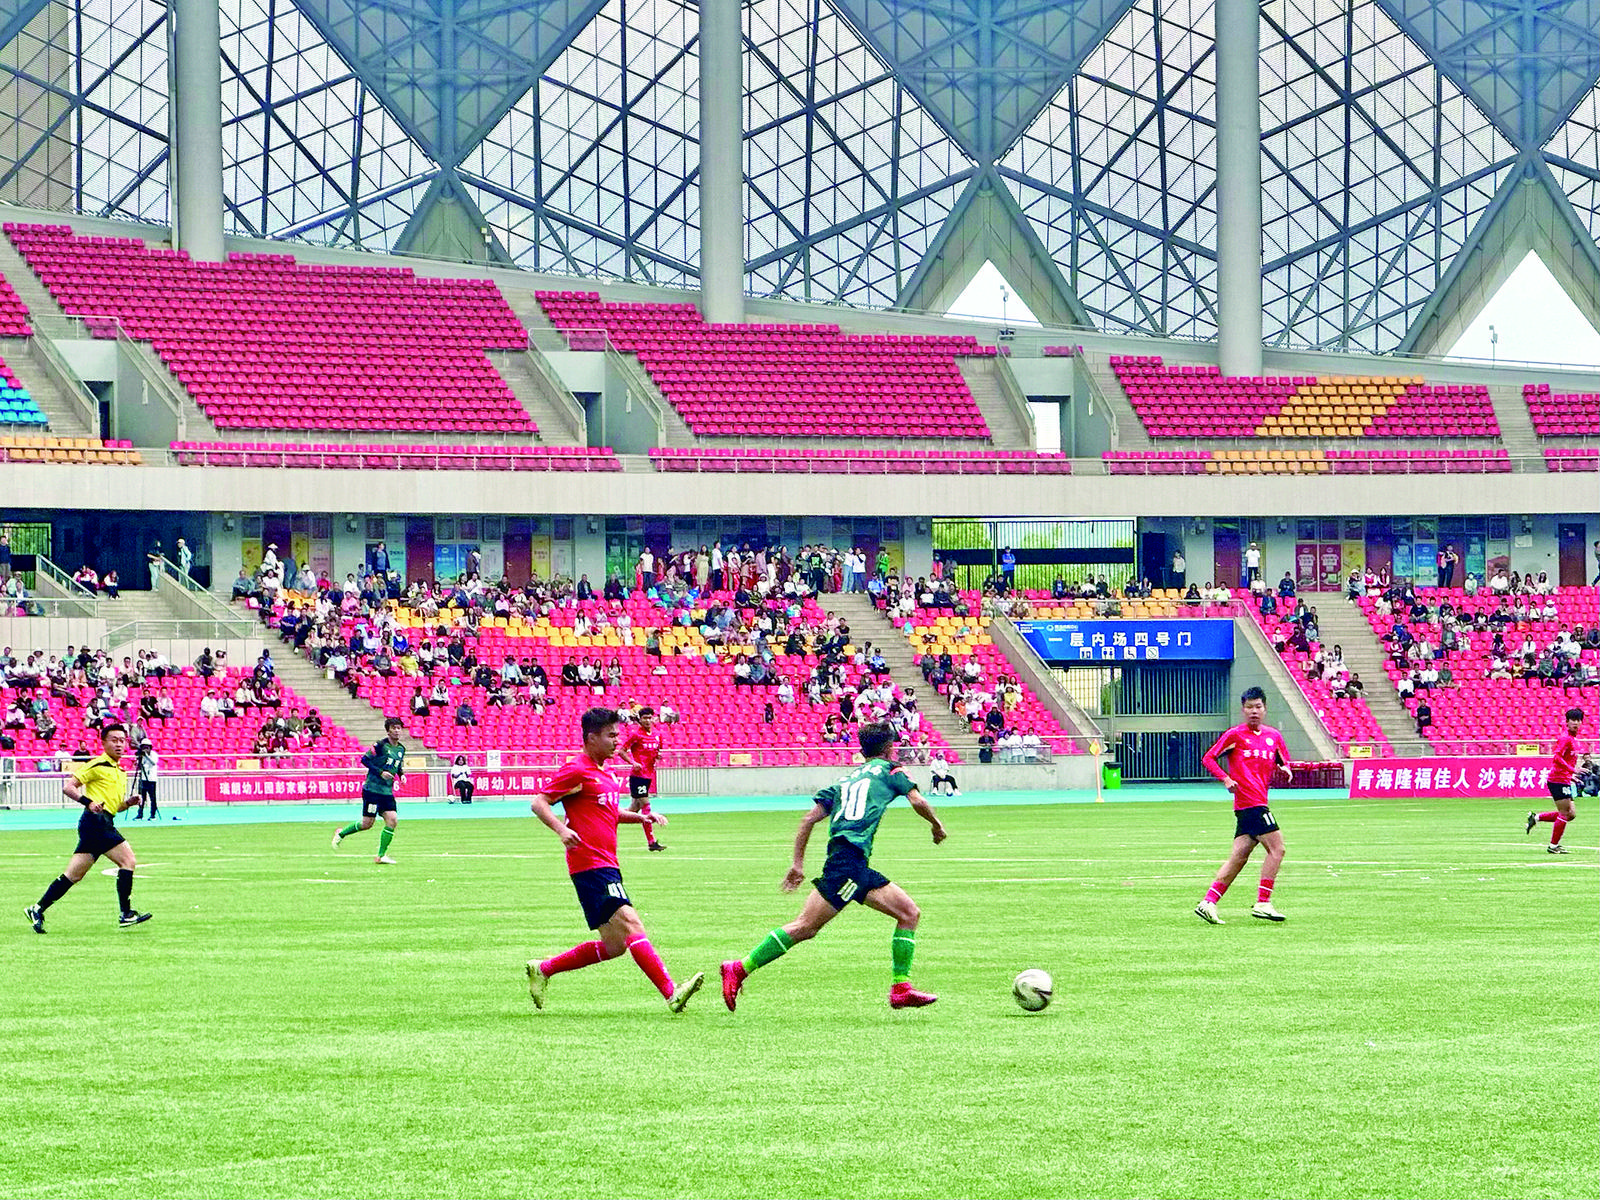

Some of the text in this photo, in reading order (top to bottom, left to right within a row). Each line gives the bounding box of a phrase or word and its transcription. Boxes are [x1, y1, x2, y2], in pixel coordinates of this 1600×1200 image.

[1048, 631, 1191, 647] 一层内场四号门
[1357, 767, 1470, 790] 青海隆福佳人
[832, 778, 871, 822] 10
[837, 878, 859, 903] 10
